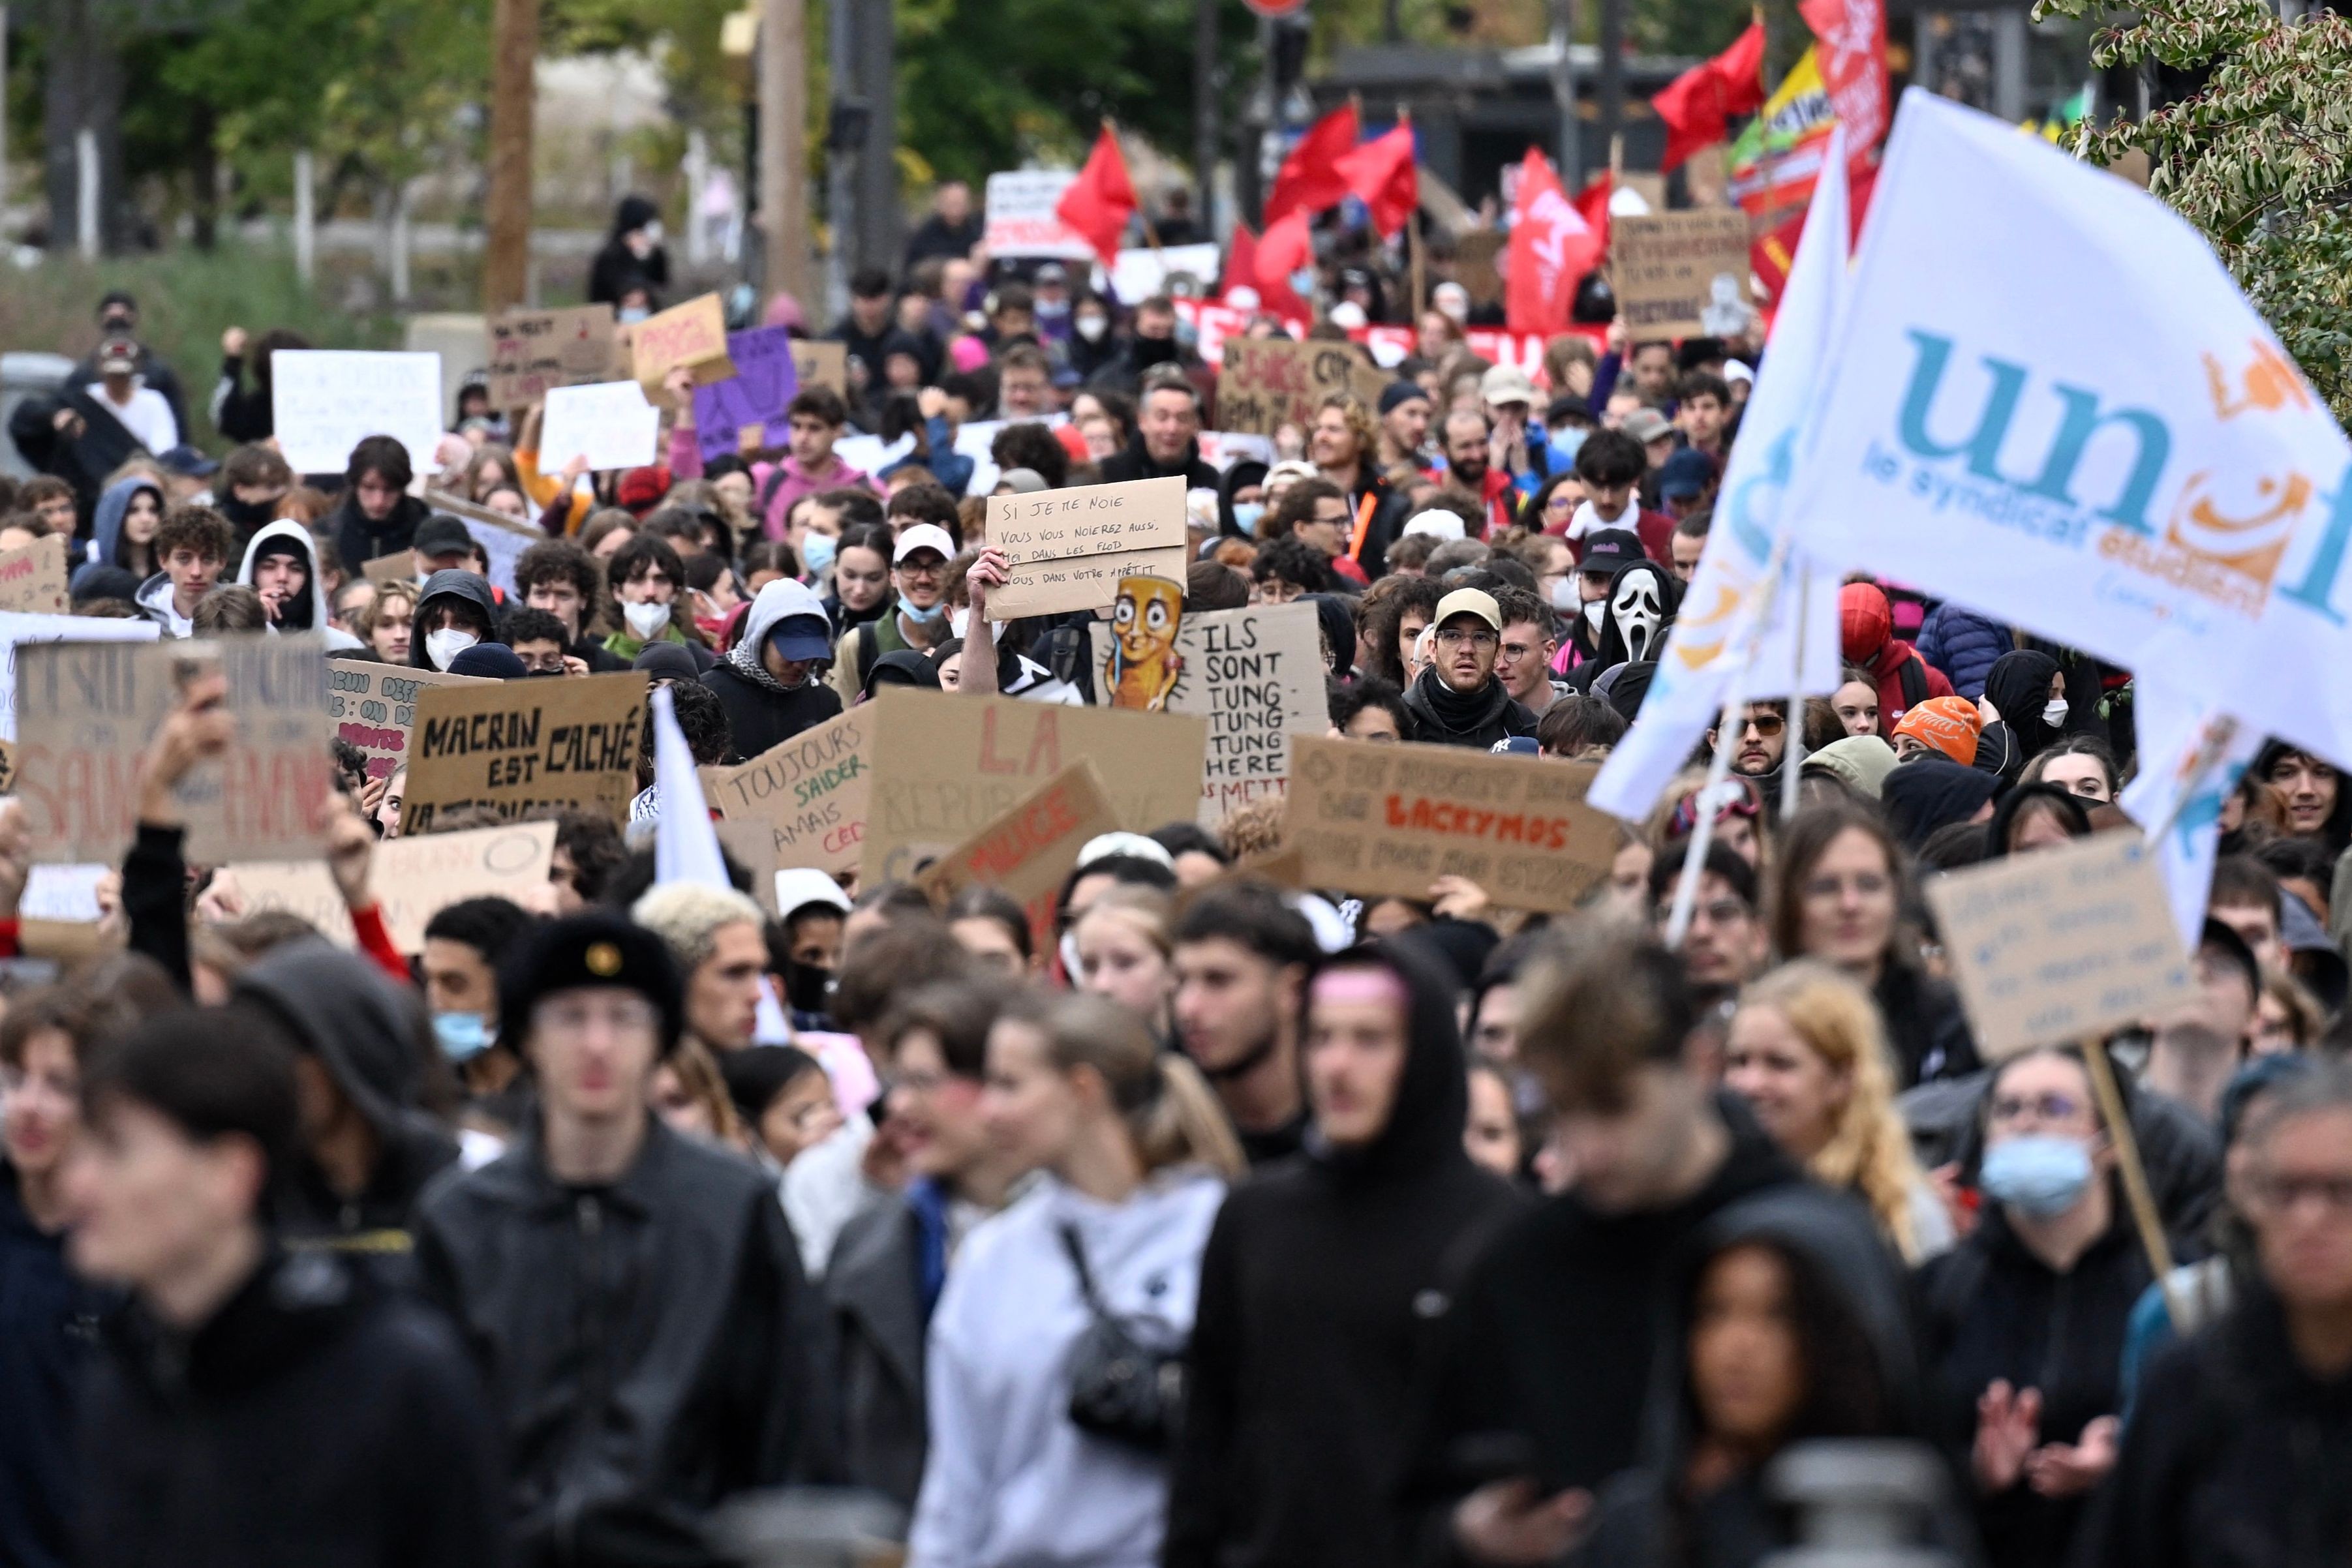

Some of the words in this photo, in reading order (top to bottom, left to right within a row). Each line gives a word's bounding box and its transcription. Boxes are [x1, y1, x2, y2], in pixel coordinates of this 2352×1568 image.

[1030, 501, 1055, 517] JE
[1909, 464, 2088, 554] syndicat
[1001, 531, 1032, 544] VOUS
[1039, 528, 1065, 541] VOUS
[1032, 548, 1056, 560] DANS
[1066, 546, 1084, 556] LES
[1043, 571, 1066, 582] DANS
[1073, 569, 1103, 580] VOTRE
[1202, 618, 1258, 653] ILS
[1206, 652, 1282, 683] SONT
[360, 700, 387, 723] ON
[423, 707, 542, 759] MACRON
[487, 753, 540, 788] EST
[545, 705, 640, 774] CACHÉ
[980, 704, 1061, 776] LA
[1211, 731, 1282, 755] TUNG
[728, 721, 861, 806] TOUJOURS
[794, 754, 868, 808] S'AIDER
[772, 802, 842, 853] AMAIS
[1384, 793, 1570, 851] LACRYMOS
